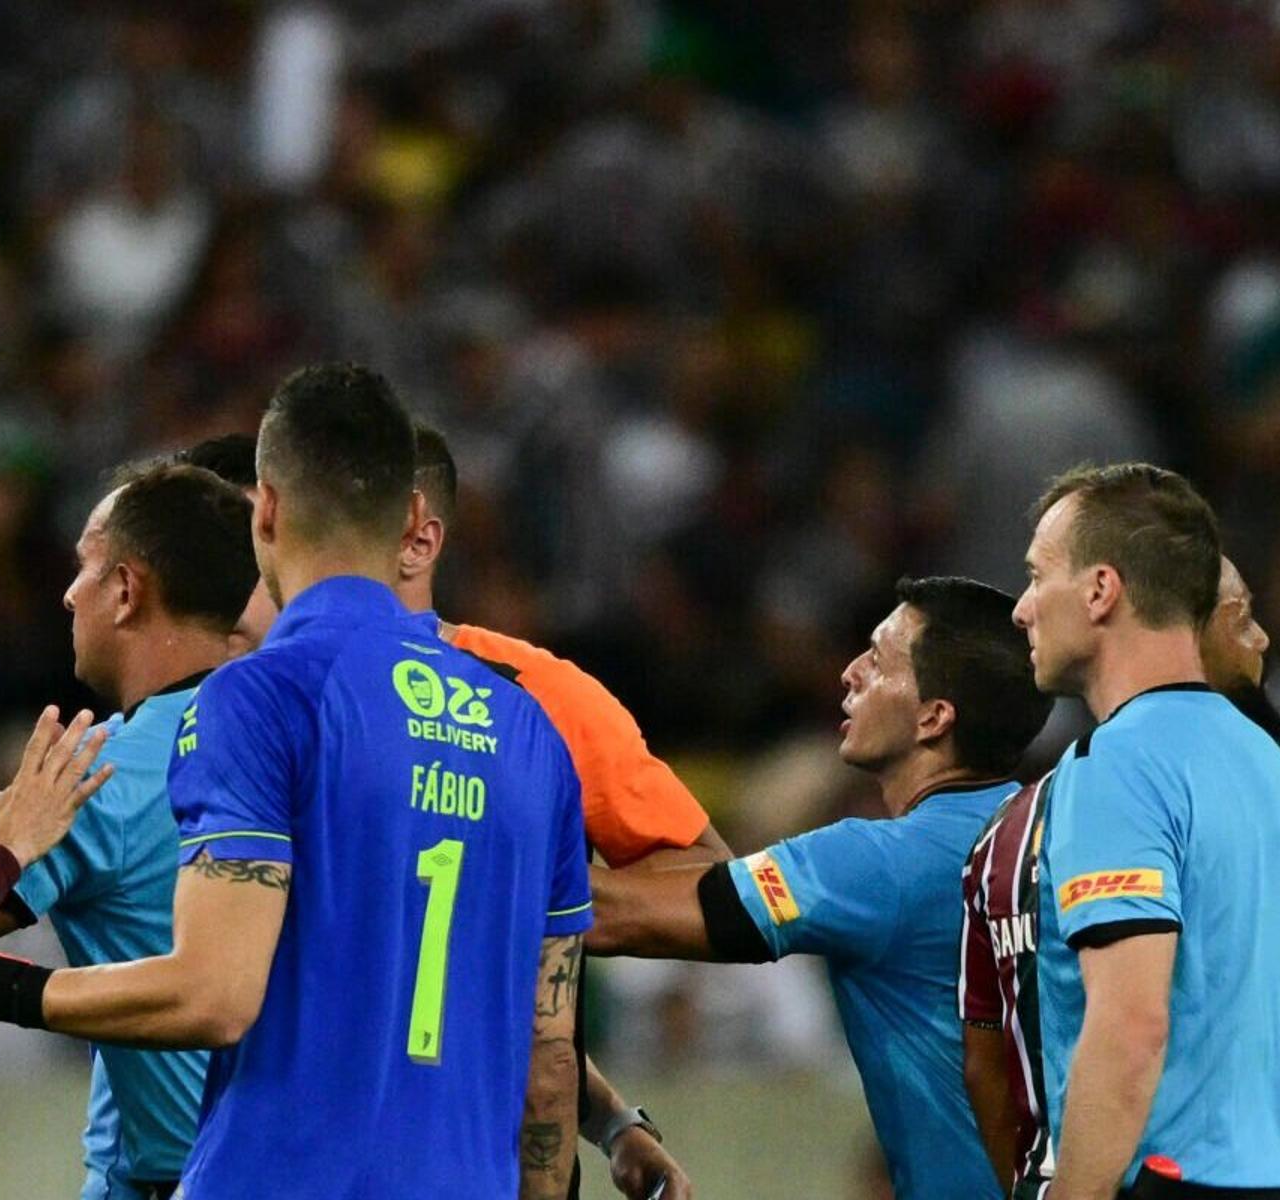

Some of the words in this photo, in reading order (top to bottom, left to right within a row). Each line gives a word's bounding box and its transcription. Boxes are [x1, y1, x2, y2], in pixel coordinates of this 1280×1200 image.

[407, 717, 497, 755] DELIVERY
[410, 760, 485, 821] FÁBIO
[1068, 873, 1144, 903] DHL
[407, 838, 464, 1058] 1
